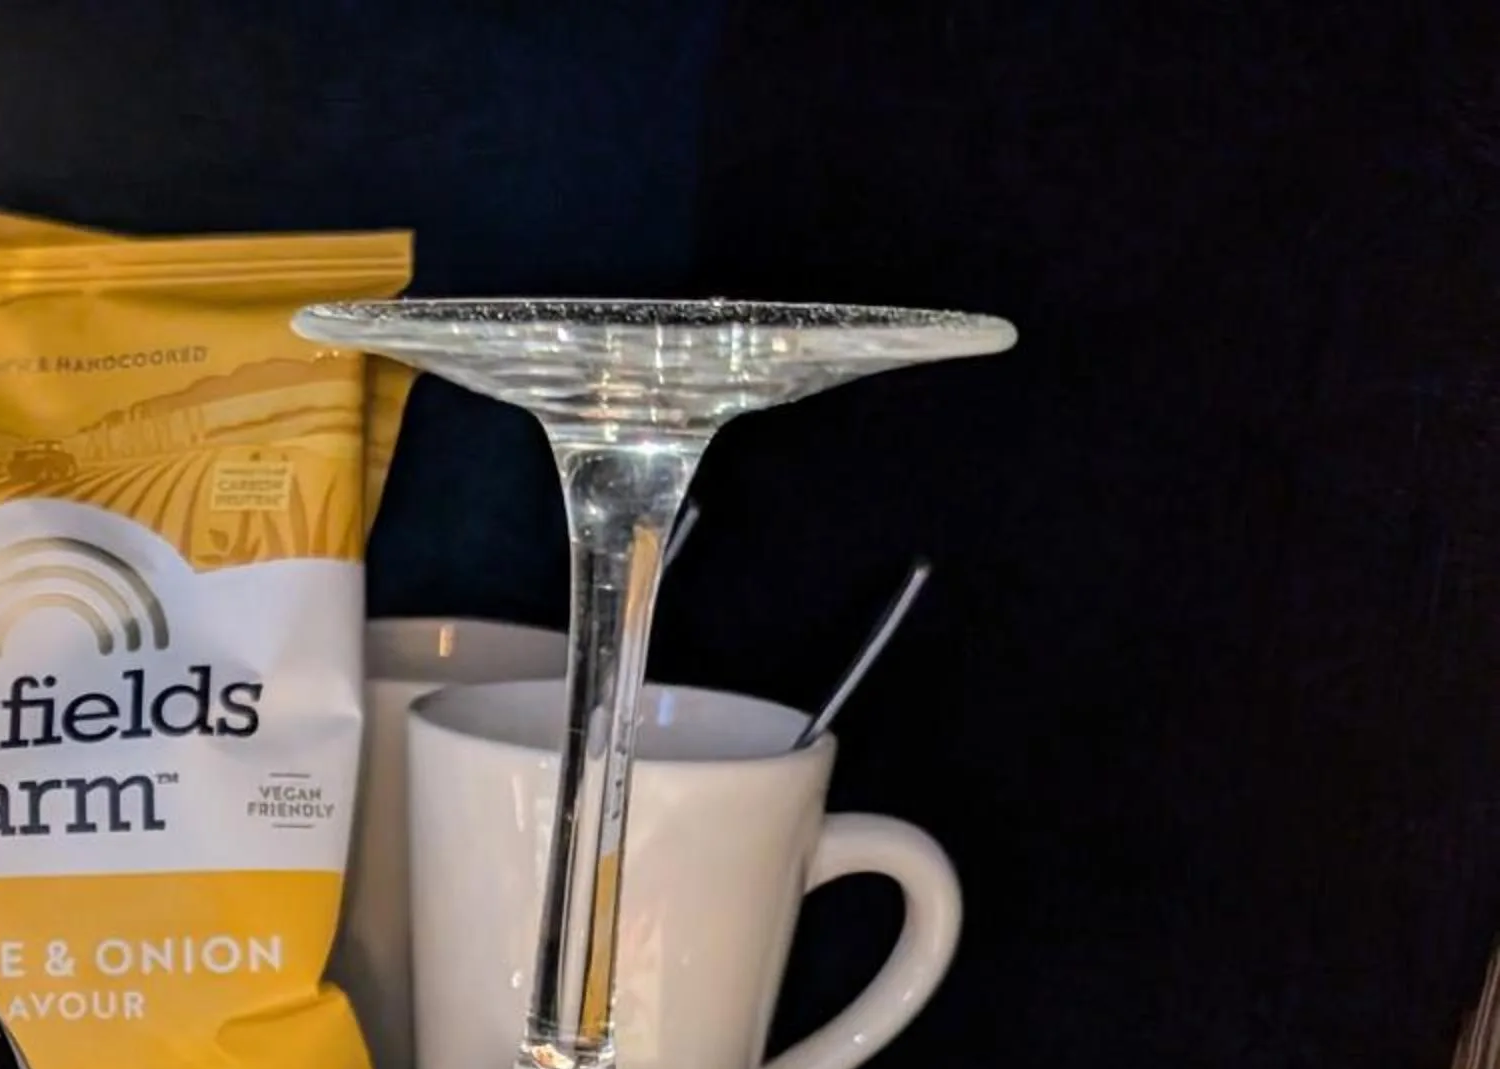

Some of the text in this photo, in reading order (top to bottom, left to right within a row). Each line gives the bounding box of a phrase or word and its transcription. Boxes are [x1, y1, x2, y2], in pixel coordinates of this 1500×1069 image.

[55, 346, 208, 374] HANDCOOKED
[259, 784, 321, 801] VEGAN
[247, 801, 335, 819] FRIENDLY
[44, 939, 77, 978] &
[95, 934, 283, 977] ONION
[7, 991, 146, 1021] AVOUR
